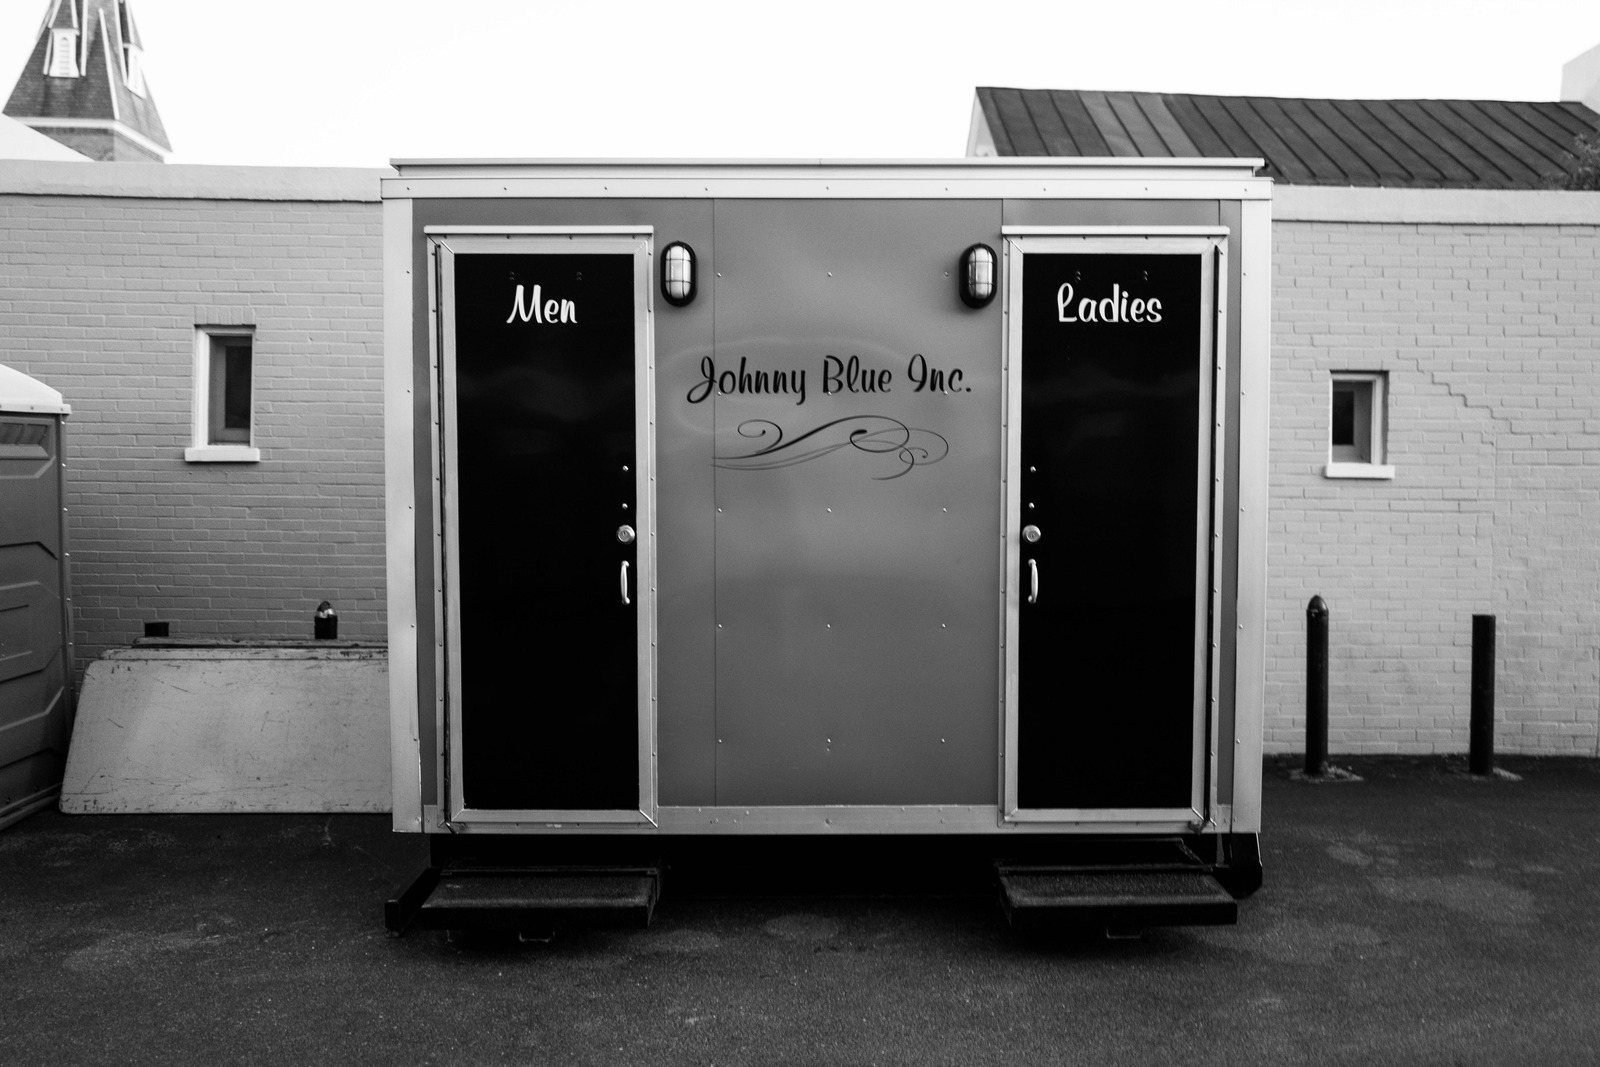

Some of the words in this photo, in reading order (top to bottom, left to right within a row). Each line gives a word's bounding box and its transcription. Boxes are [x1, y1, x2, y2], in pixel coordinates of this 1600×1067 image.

[506, 284, 578, 324] Men
[1056, 282, 1163, 323] Ladies
[686, 355, 807, 405] Johnny
[822, 354, 893, 394] Blue
[907, 353, 973, 394] Inc.
